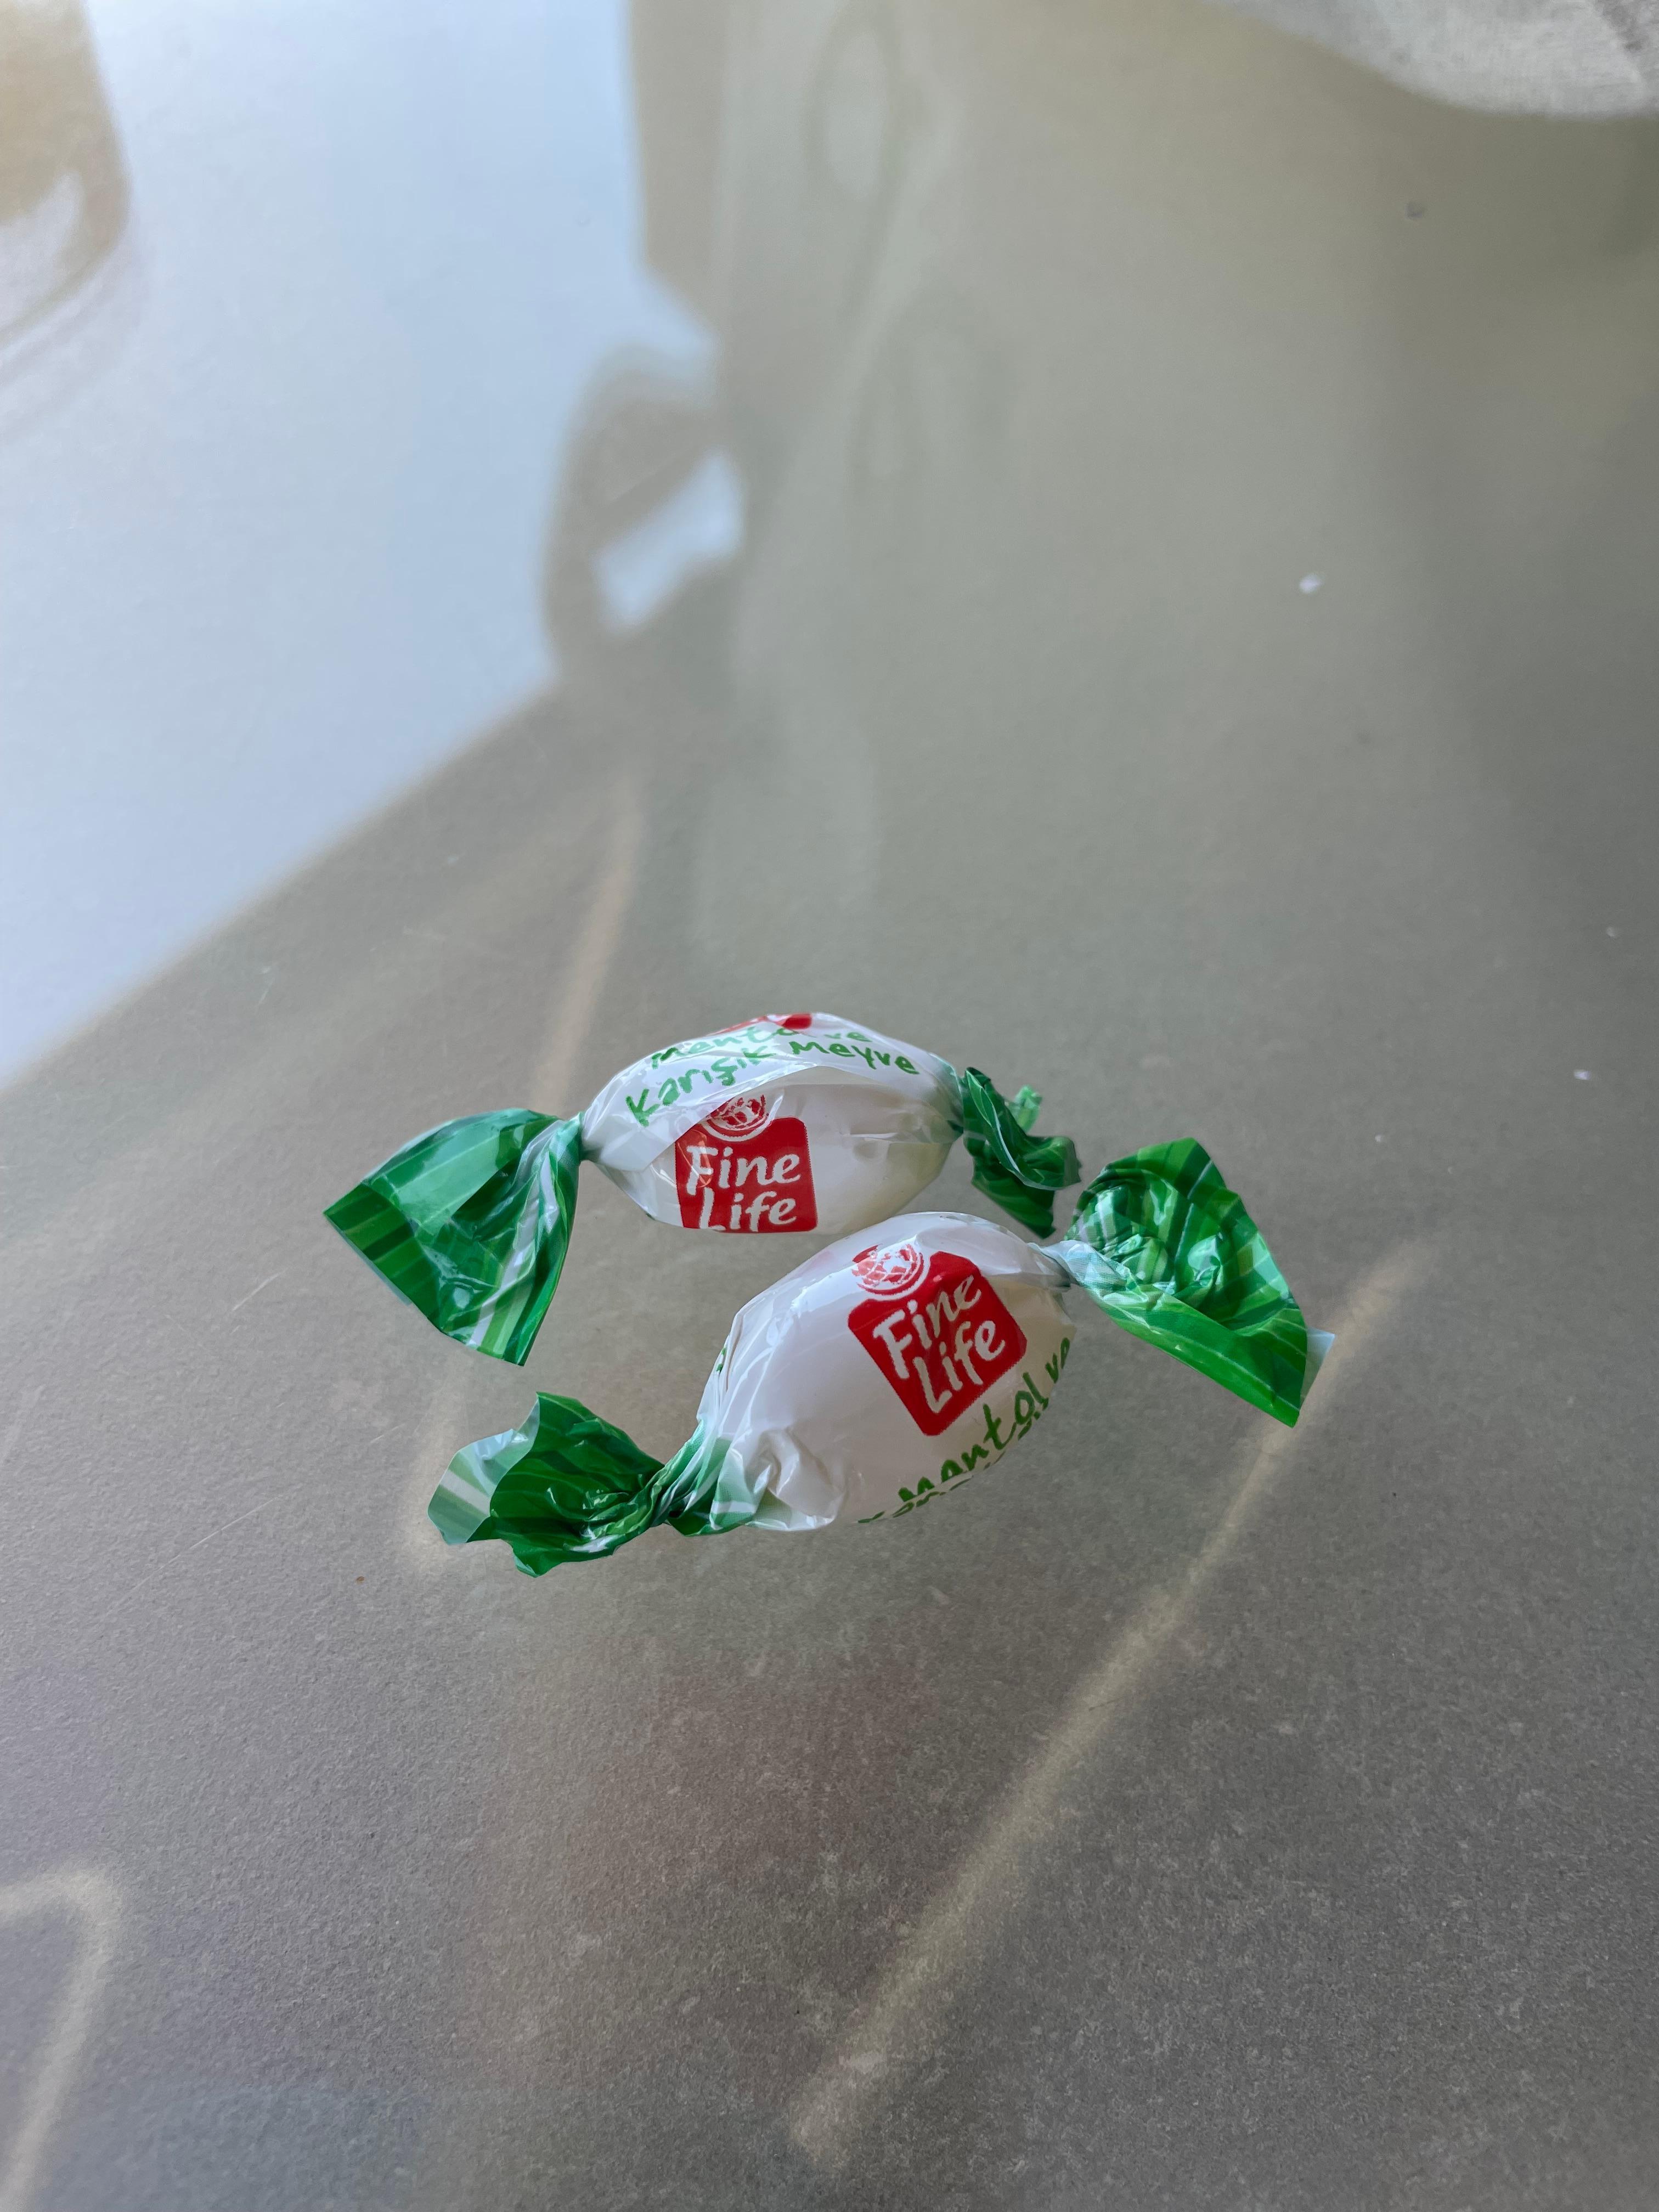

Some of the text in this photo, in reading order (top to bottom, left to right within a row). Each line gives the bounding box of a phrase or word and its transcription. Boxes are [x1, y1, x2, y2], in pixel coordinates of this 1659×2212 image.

[686, 1144, 802, 1196] Fine
[698, 1186, 797, 1233] Life
[872, 1274, 982, 1380] Fine
[912, 1319, 1006, 1414] Life
